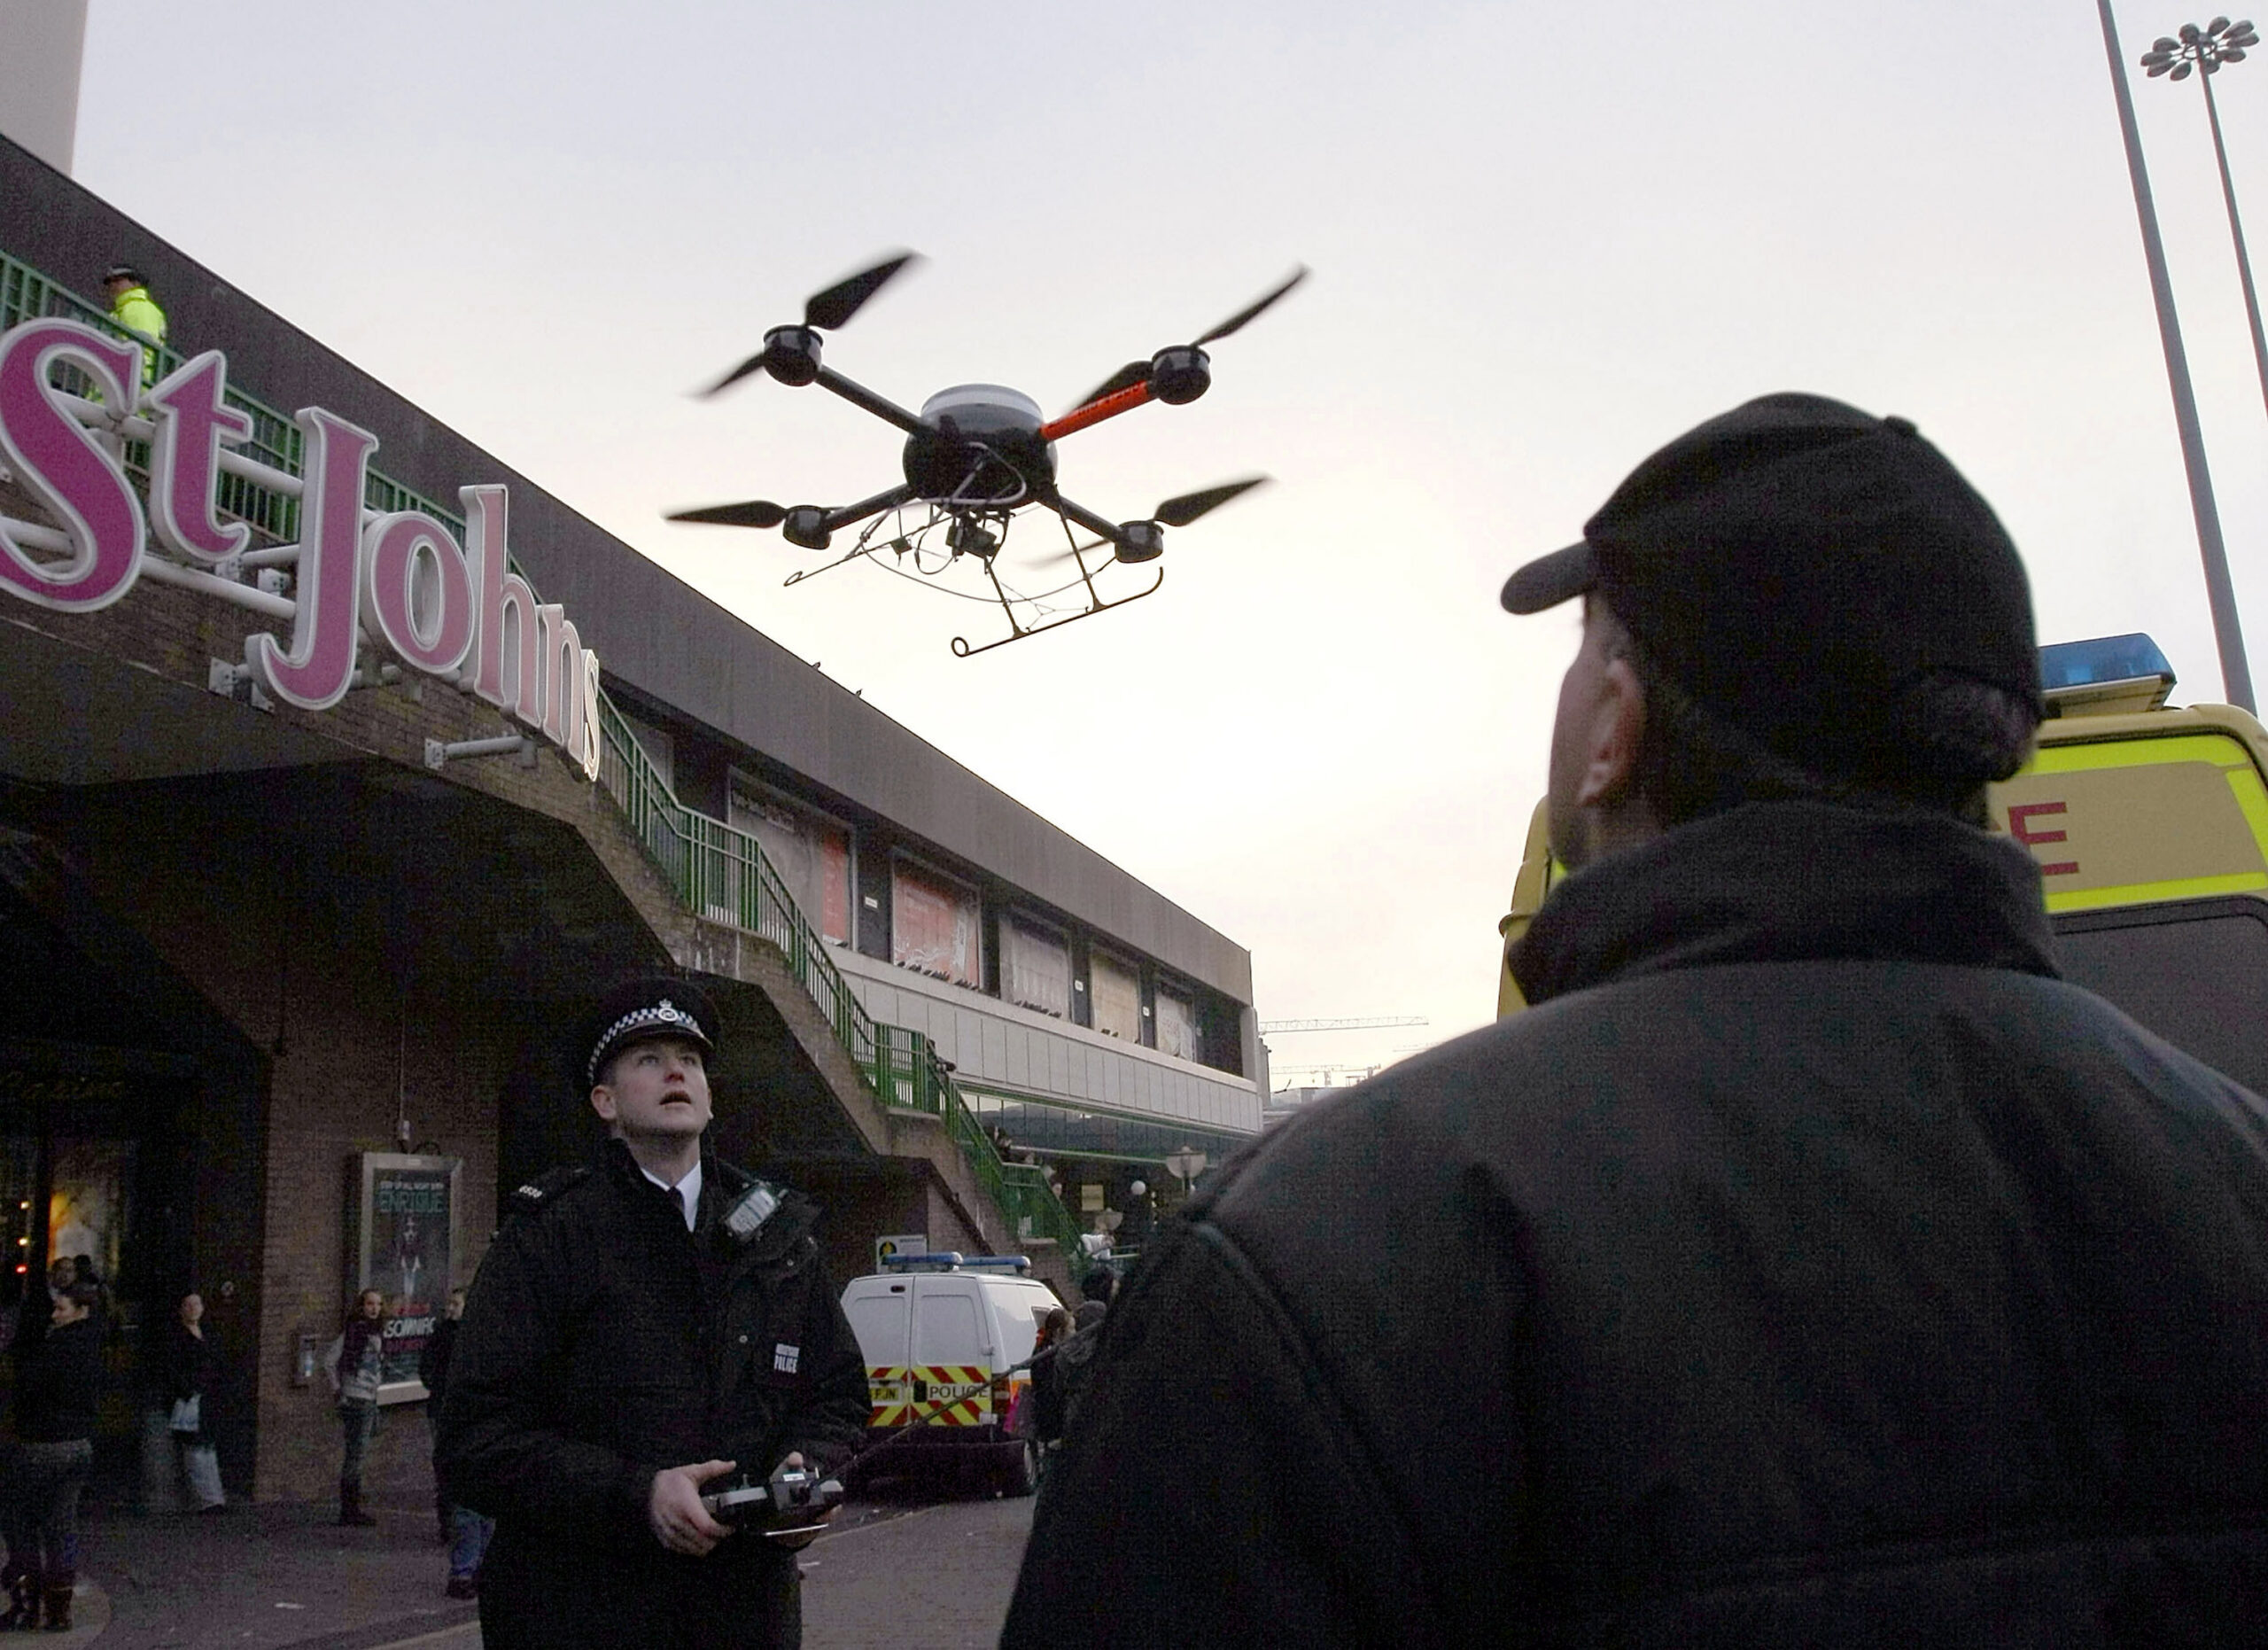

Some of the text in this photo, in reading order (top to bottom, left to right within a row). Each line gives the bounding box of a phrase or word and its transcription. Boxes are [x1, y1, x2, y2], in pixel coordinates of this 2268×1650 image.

[0, 317, 600, 782] St Johns
[2006, 801, 2079, 876] E
[774, 1355, 798, 1374] POLICE
